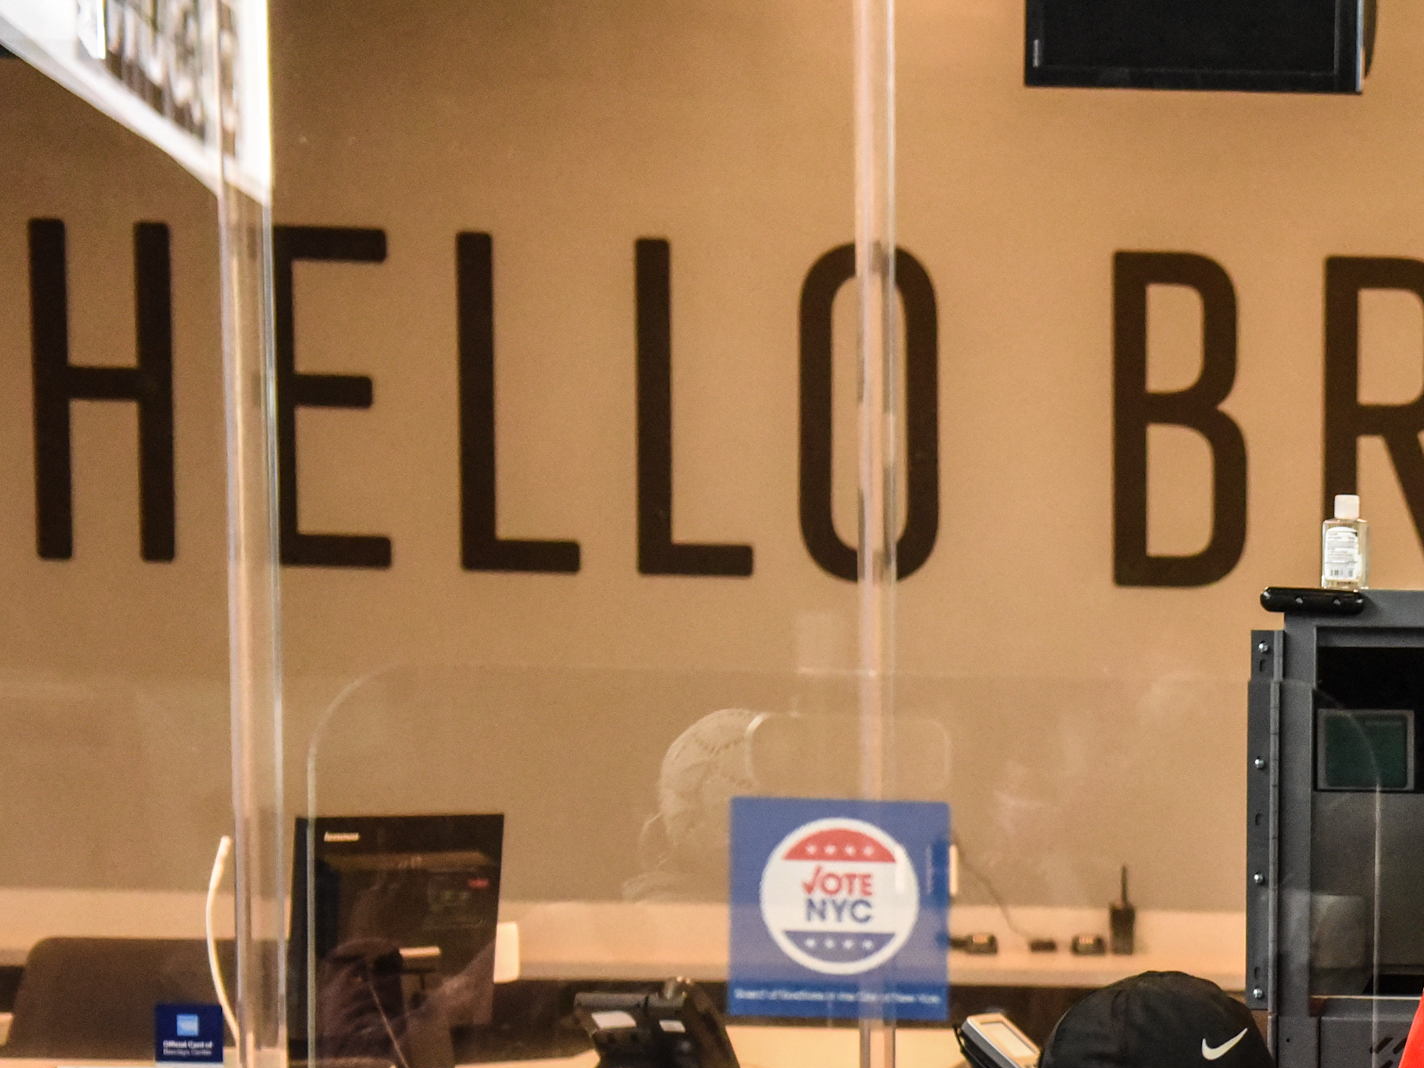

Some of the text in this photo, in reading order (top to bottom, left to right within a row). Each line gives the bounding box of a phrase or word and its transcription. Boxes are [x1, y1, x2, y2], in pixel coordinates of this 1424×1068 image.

[28, 218, 939, 582] HELLO
[802, 865, 873, 896] VOTE
[806, 898, 873, 923] NYC
